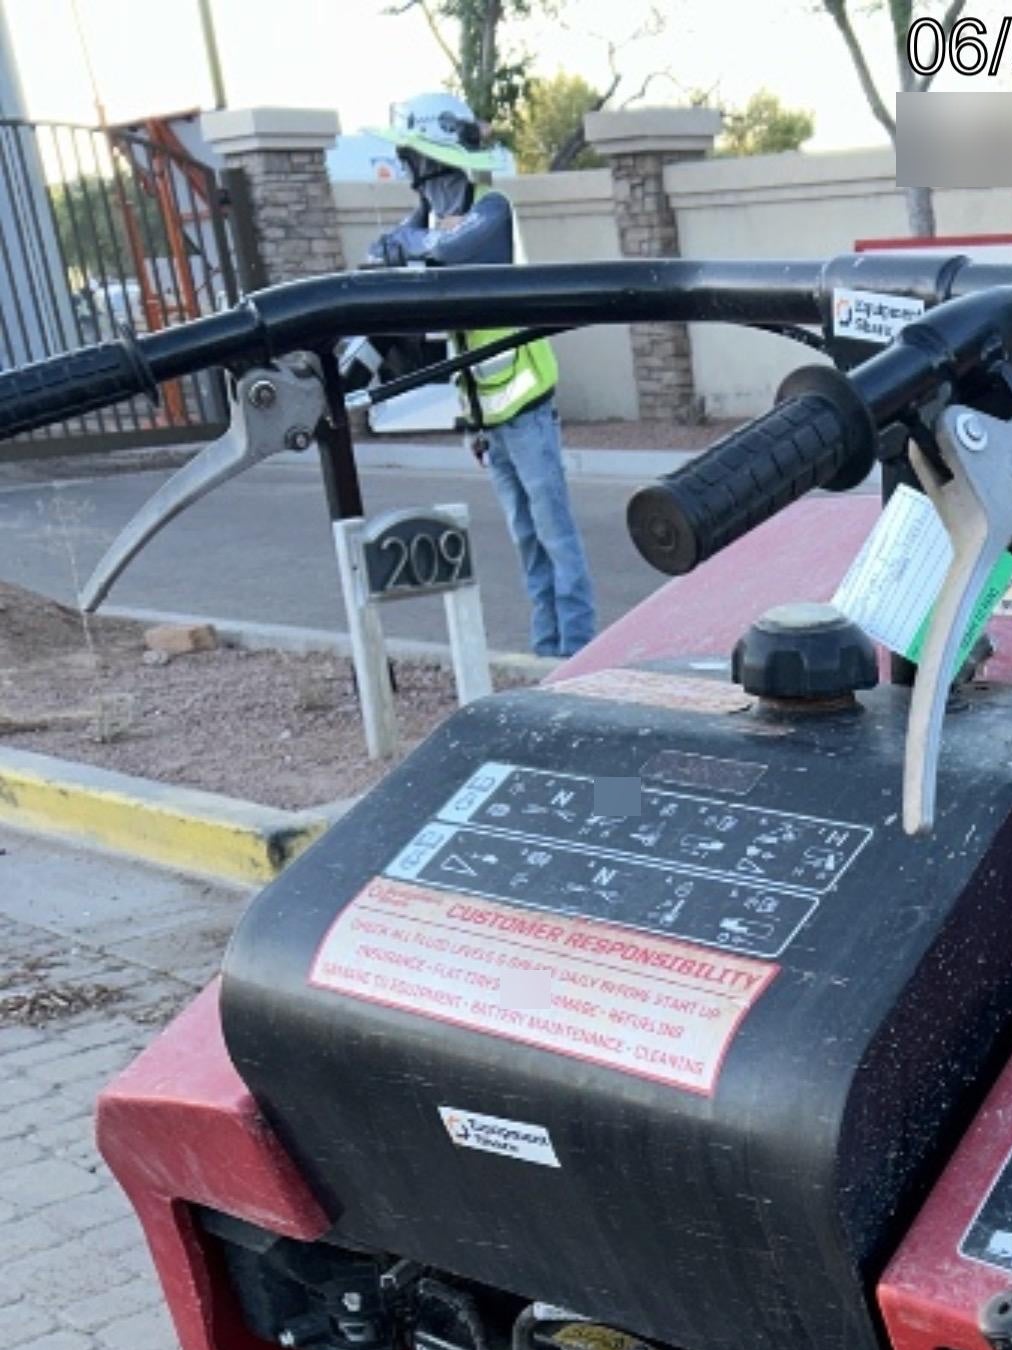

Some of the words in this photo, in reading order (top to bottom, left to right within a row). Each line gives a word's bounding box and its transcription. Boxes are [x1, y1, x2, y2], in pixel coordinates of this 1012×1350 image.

[381, 529, 465, 590] 209
[445, 902, 565, 942] CUSTOMER
[564, 931, 763, 991] RESPONSIBILITY
